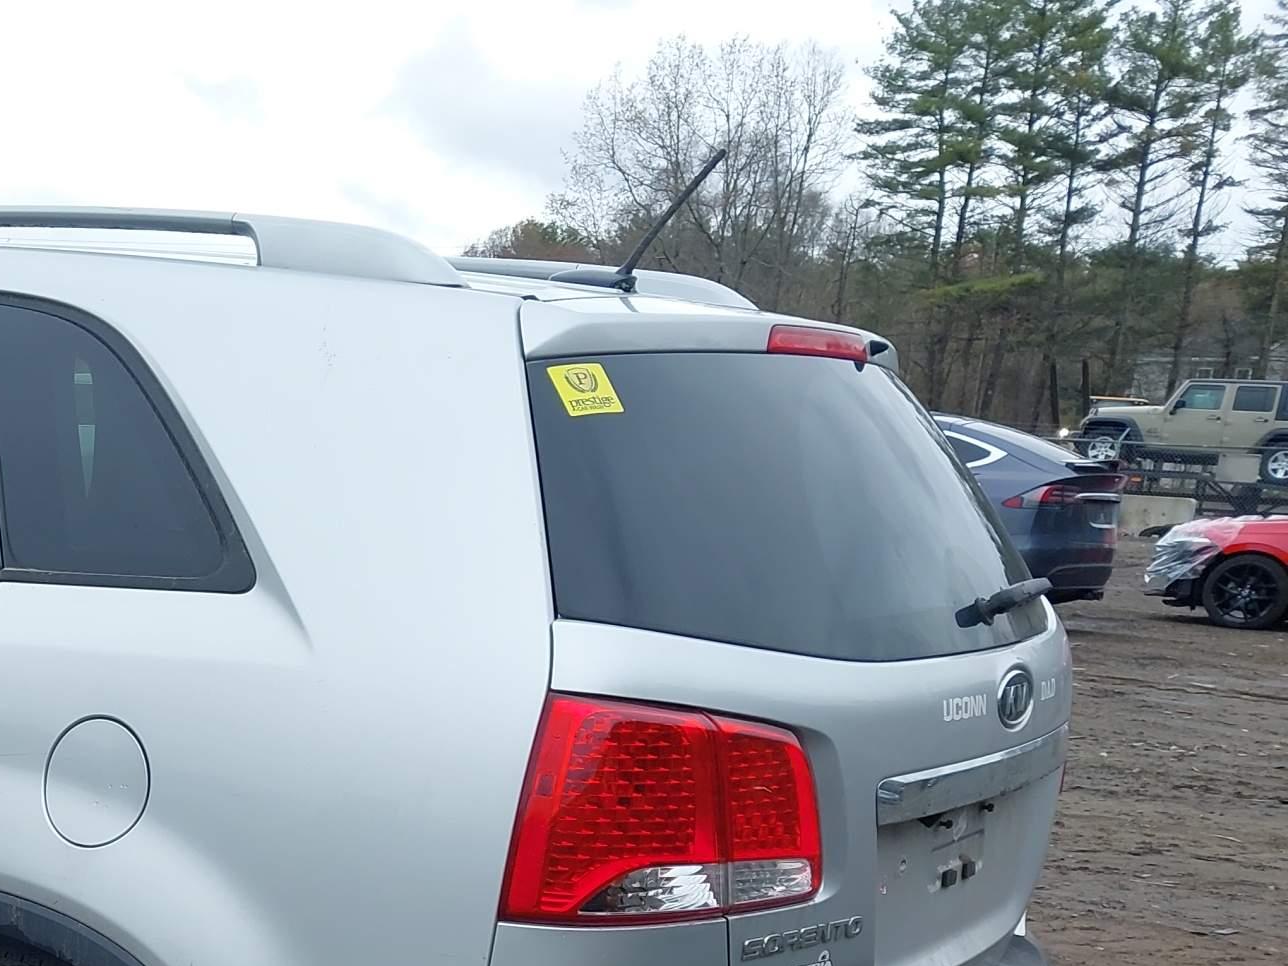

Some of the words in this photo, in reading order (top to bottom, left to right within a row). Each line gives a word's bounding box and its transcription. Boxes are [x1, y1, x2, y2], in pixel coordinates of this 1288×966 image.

[568, 395, 616, 411] prestige
[943, 694, 987, 722] UCONN
[741, 915, 864, 962] SORENTO
